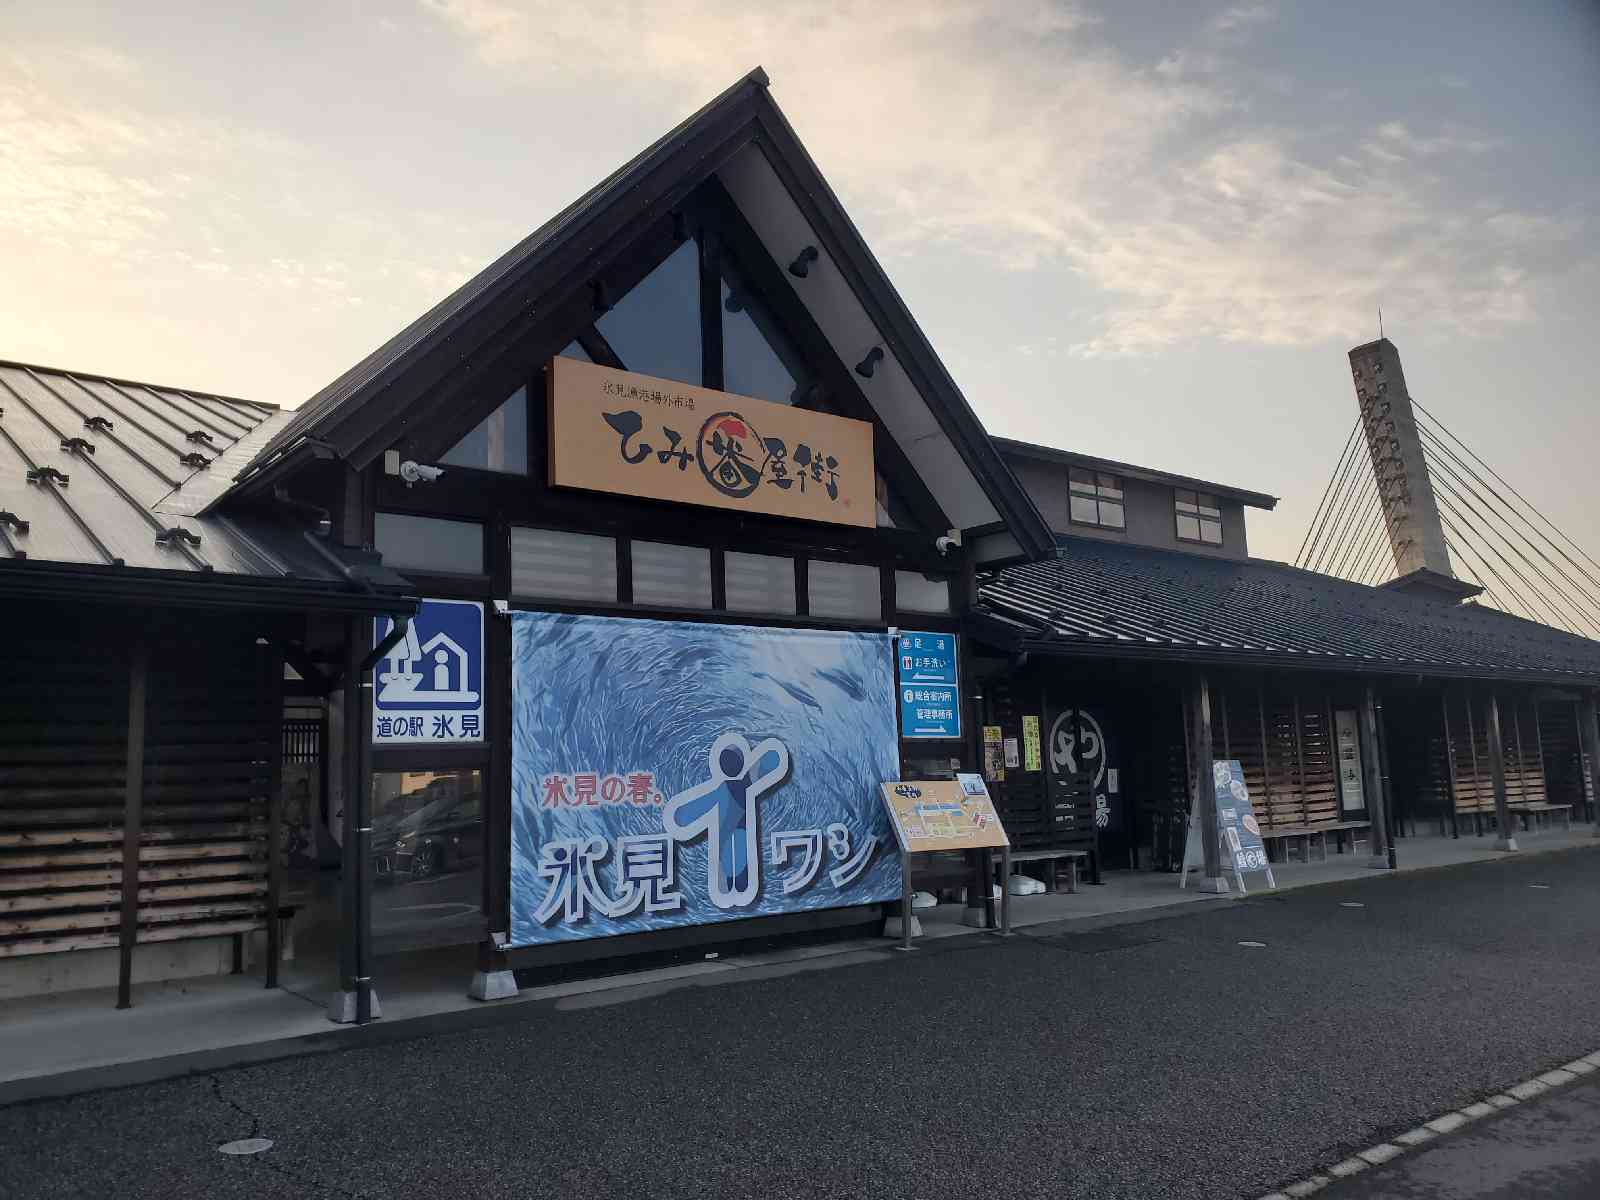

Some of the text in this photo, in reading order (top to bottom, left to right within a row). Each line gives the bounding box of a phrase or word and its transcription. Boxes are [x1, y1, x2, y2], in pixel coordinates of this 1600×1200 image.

[601, 411, 840, 500] ひみ番屋街
[915, 658, 946, 668] お手洗い
[376, 714, 481, 739] 道の駅 氷見
